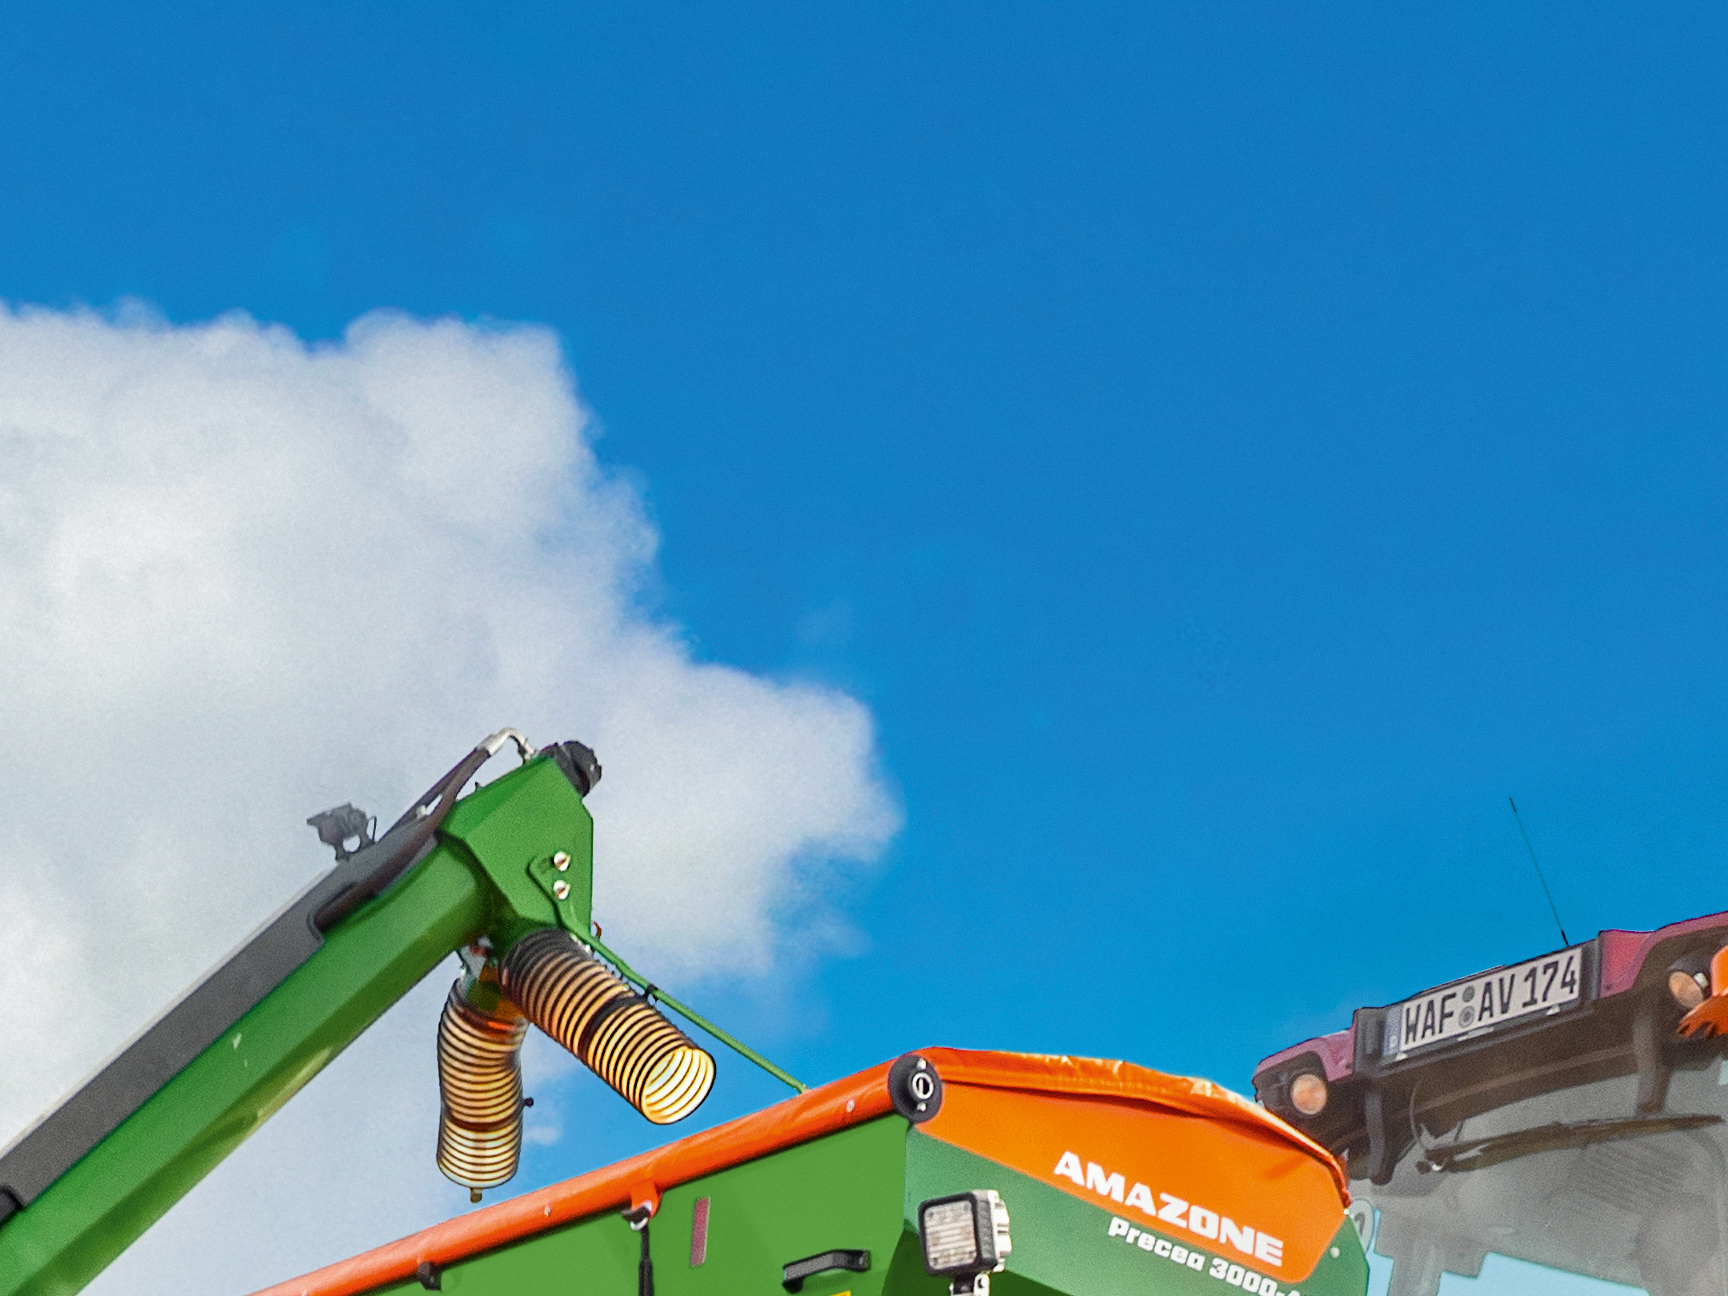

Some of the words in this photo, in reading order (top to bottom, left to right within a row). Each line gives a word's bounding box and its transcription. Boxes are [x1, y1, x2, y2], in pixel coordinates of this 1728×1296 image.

[1404, 991, 1457, 1045] WAF
[1477, 974, 1515, 1022] AV
[1522, 955, 1577, 1009] 174
[1053, 1150, 1283, 1267] AMAZONE
[1108, 1216, 1204, 1272] Precea
